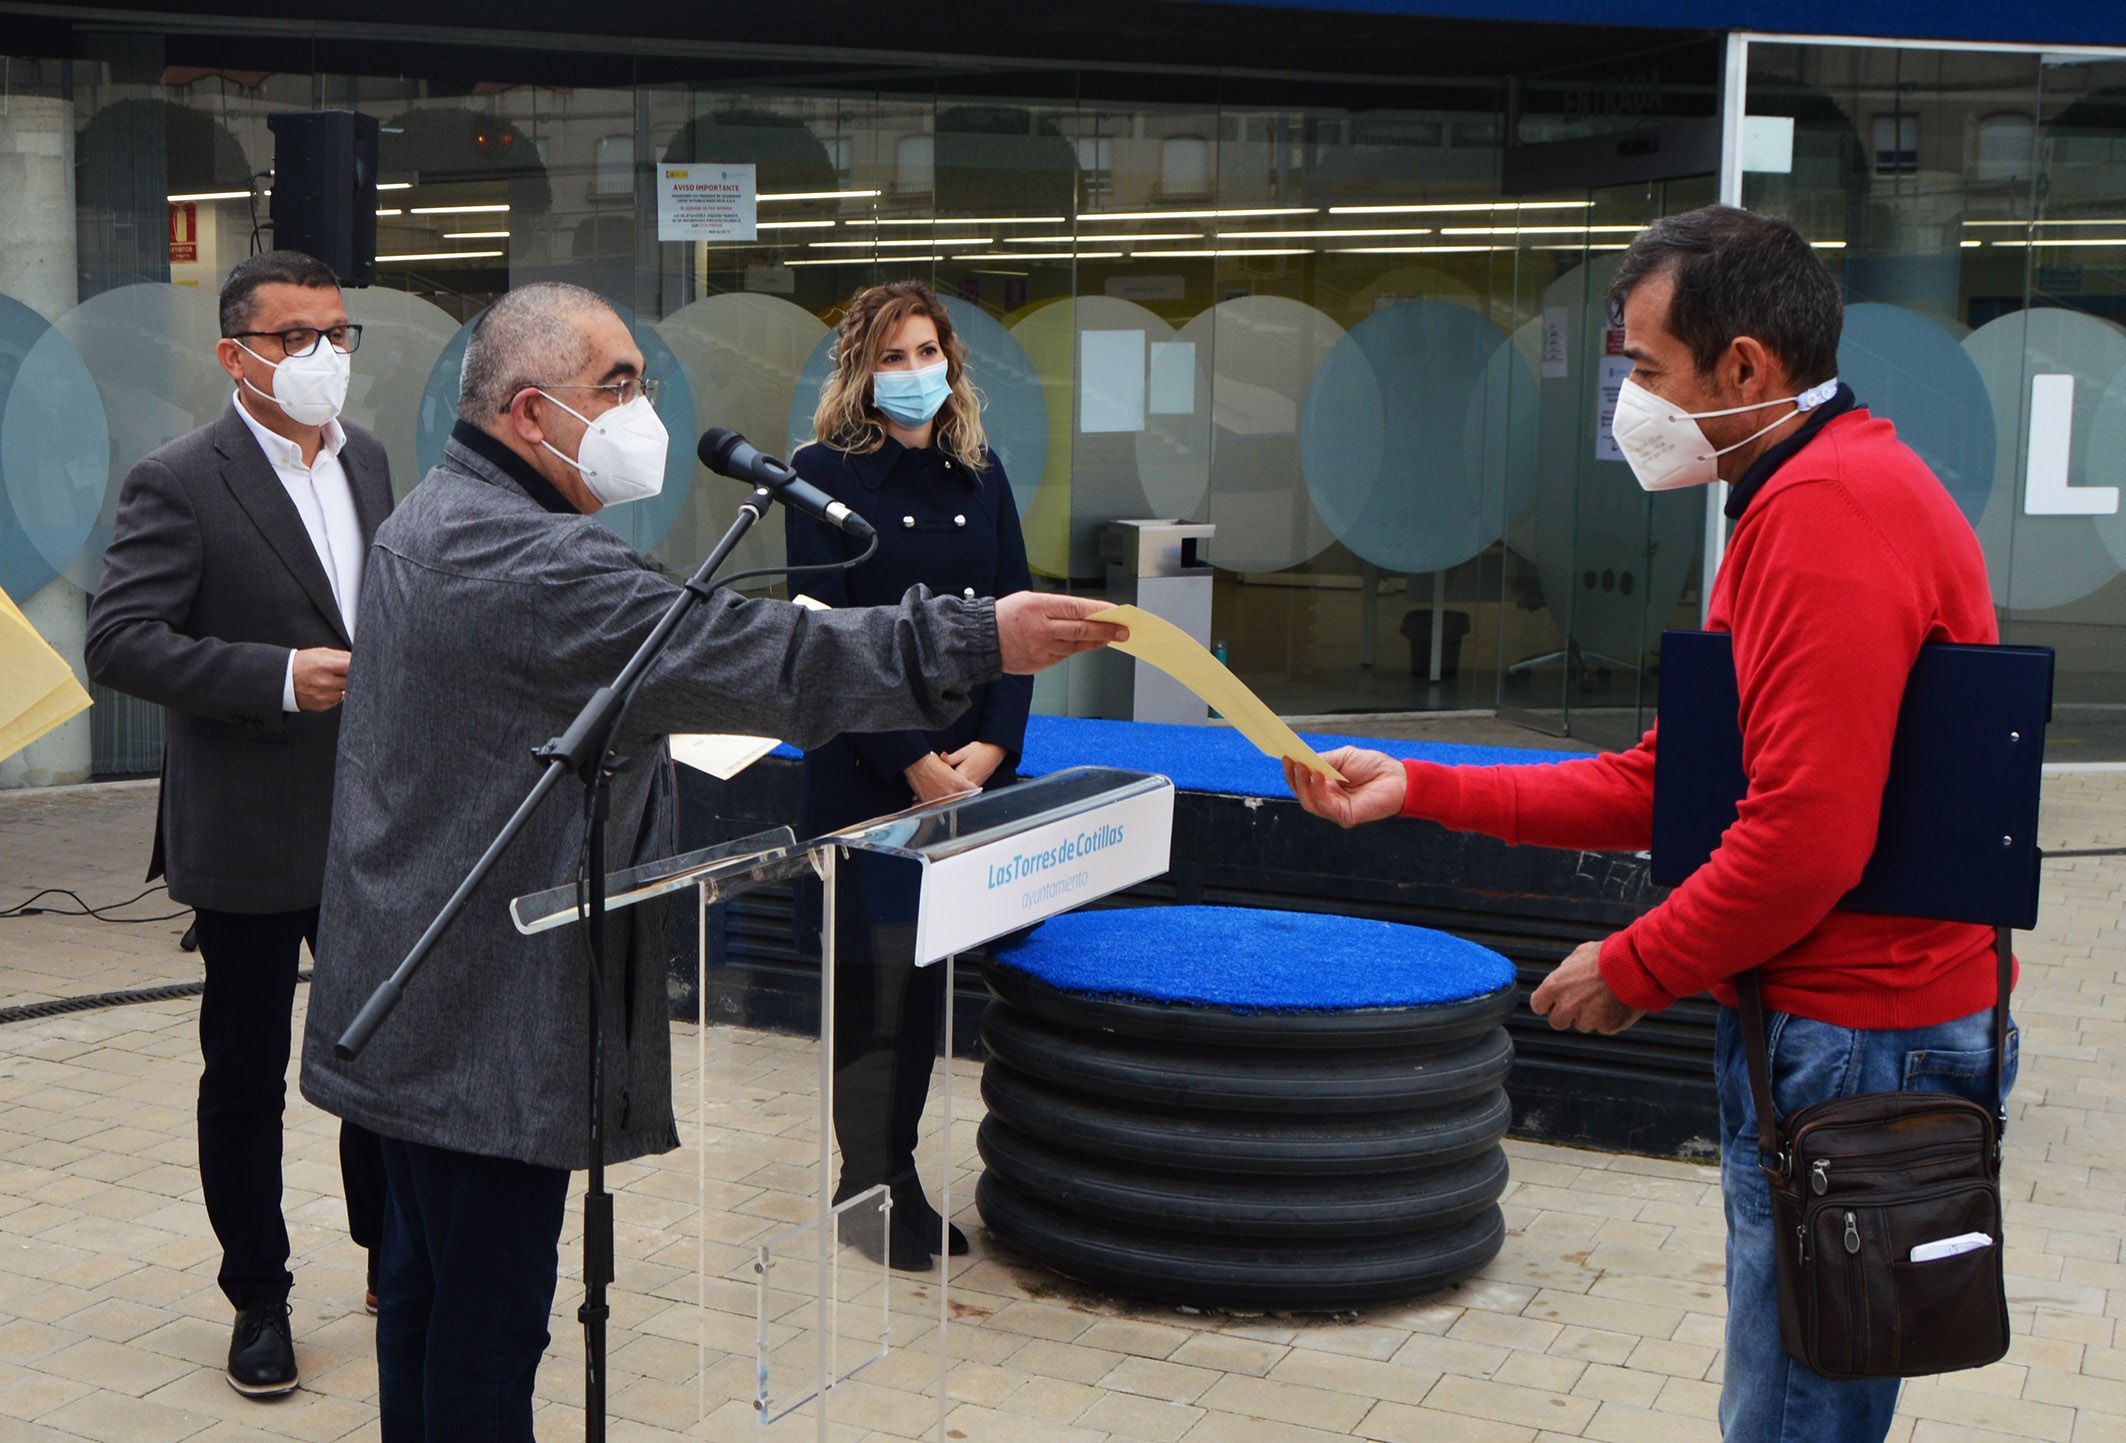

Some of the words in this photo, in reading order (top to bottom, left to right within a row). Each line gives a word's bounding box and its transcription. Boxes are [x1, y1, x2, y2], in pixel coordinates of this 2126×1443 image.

[673, 184, 694, 192] AVISO
[695, 184, 739, 192] IMPORTANTE
[2024, 374, 2119, 515] L
[988, 863, 1012, 889] Las
[1013, 848, 1057, 880] Torres
[1058, 839, 1074, 864] de
[1076, 824, 1124, 857] Cotillas
[1021, 871, 1088, 910] ayuntamiento
